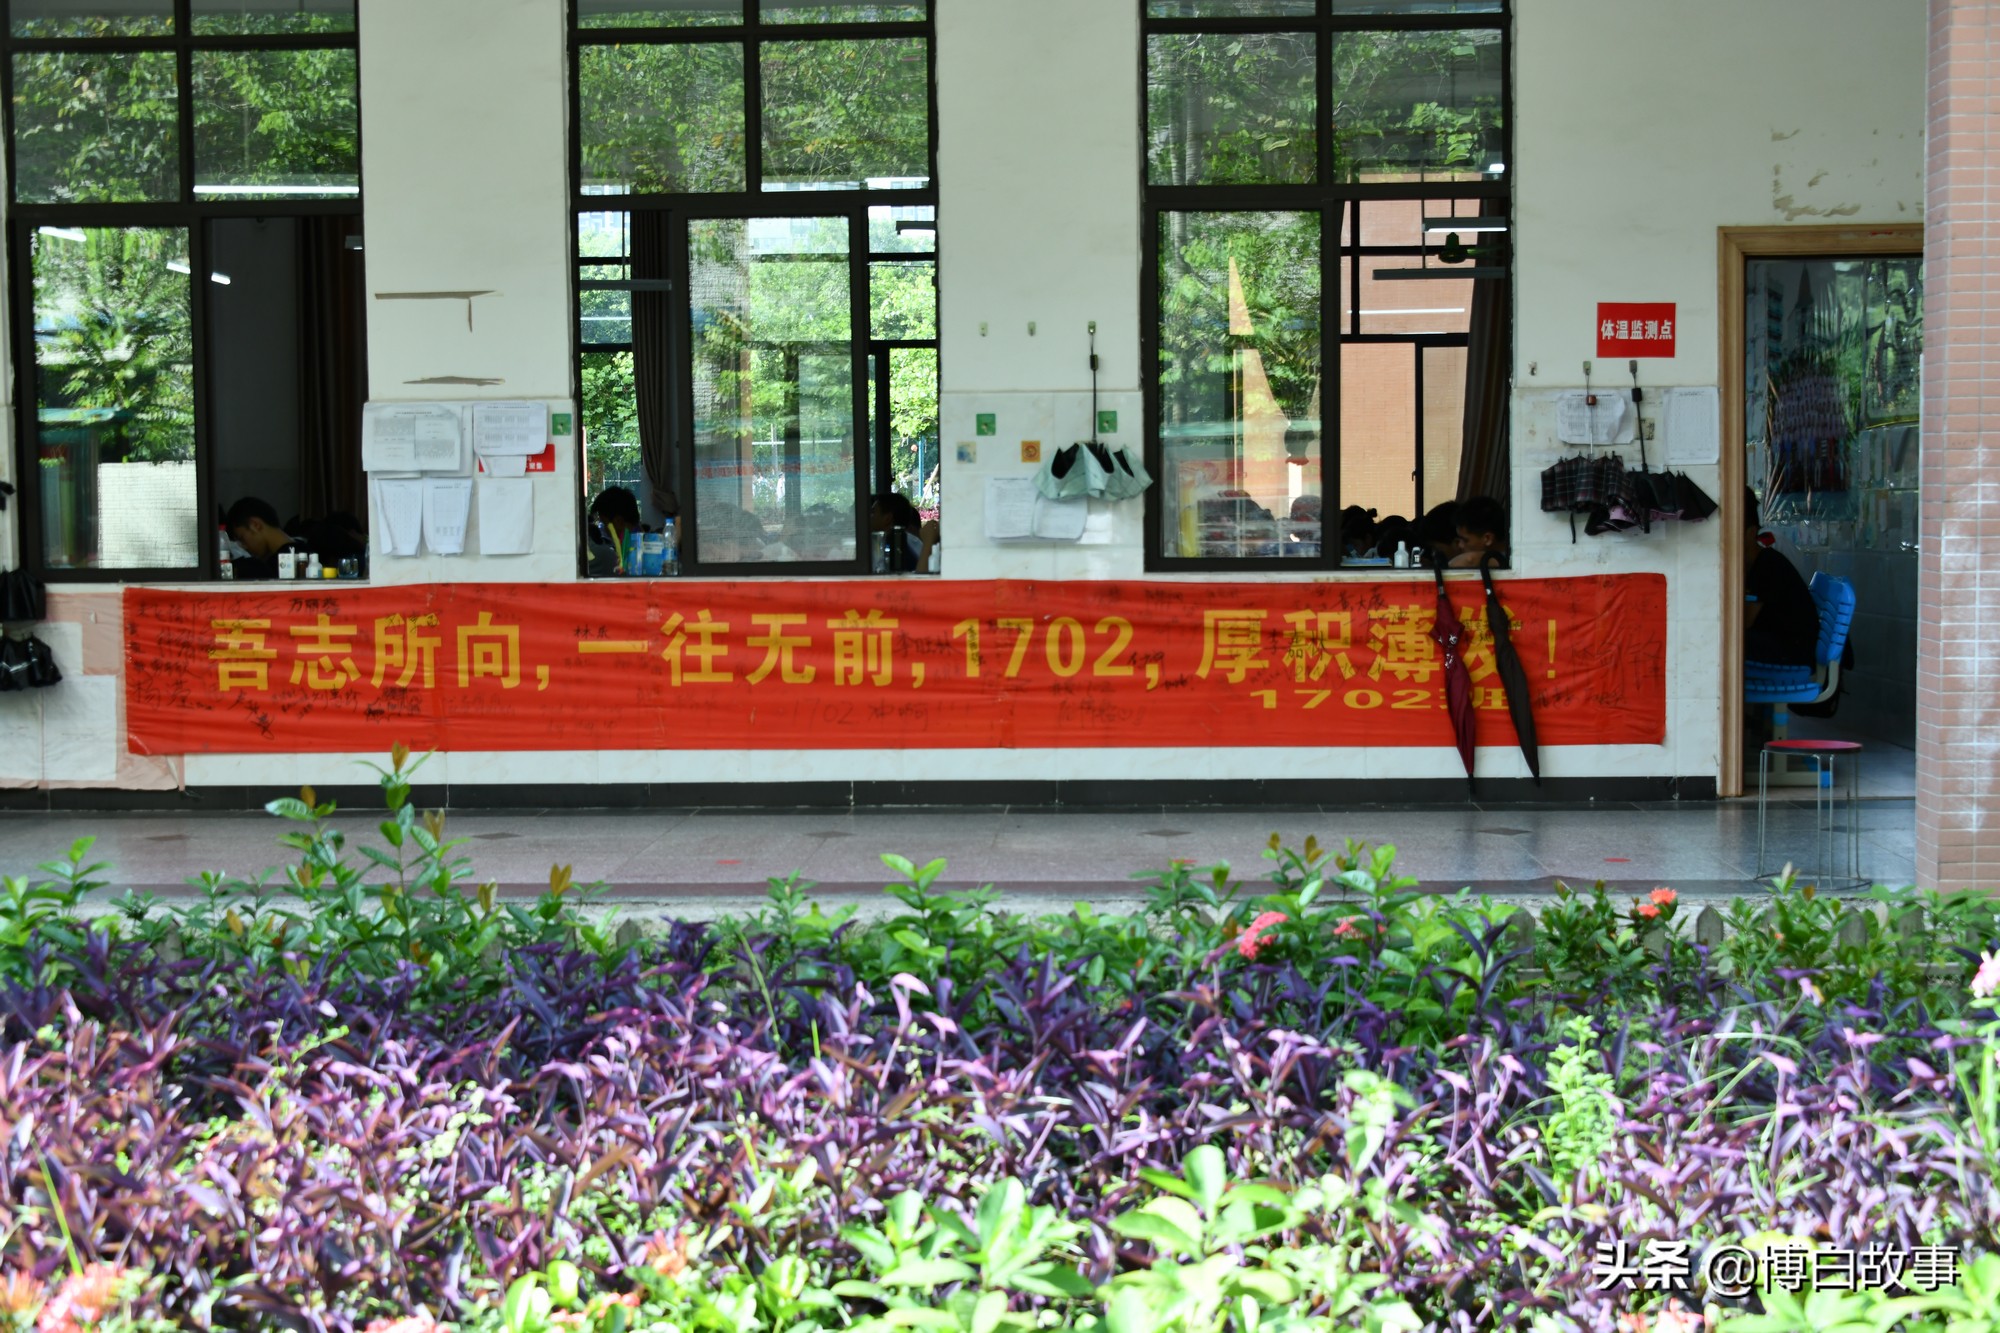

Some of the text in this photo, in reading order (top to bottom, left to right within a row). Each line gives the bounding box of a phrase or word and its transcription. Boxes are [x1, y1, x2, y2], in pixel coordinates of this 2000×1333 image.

[1601, 320, 1673, 340] 体温监测点
